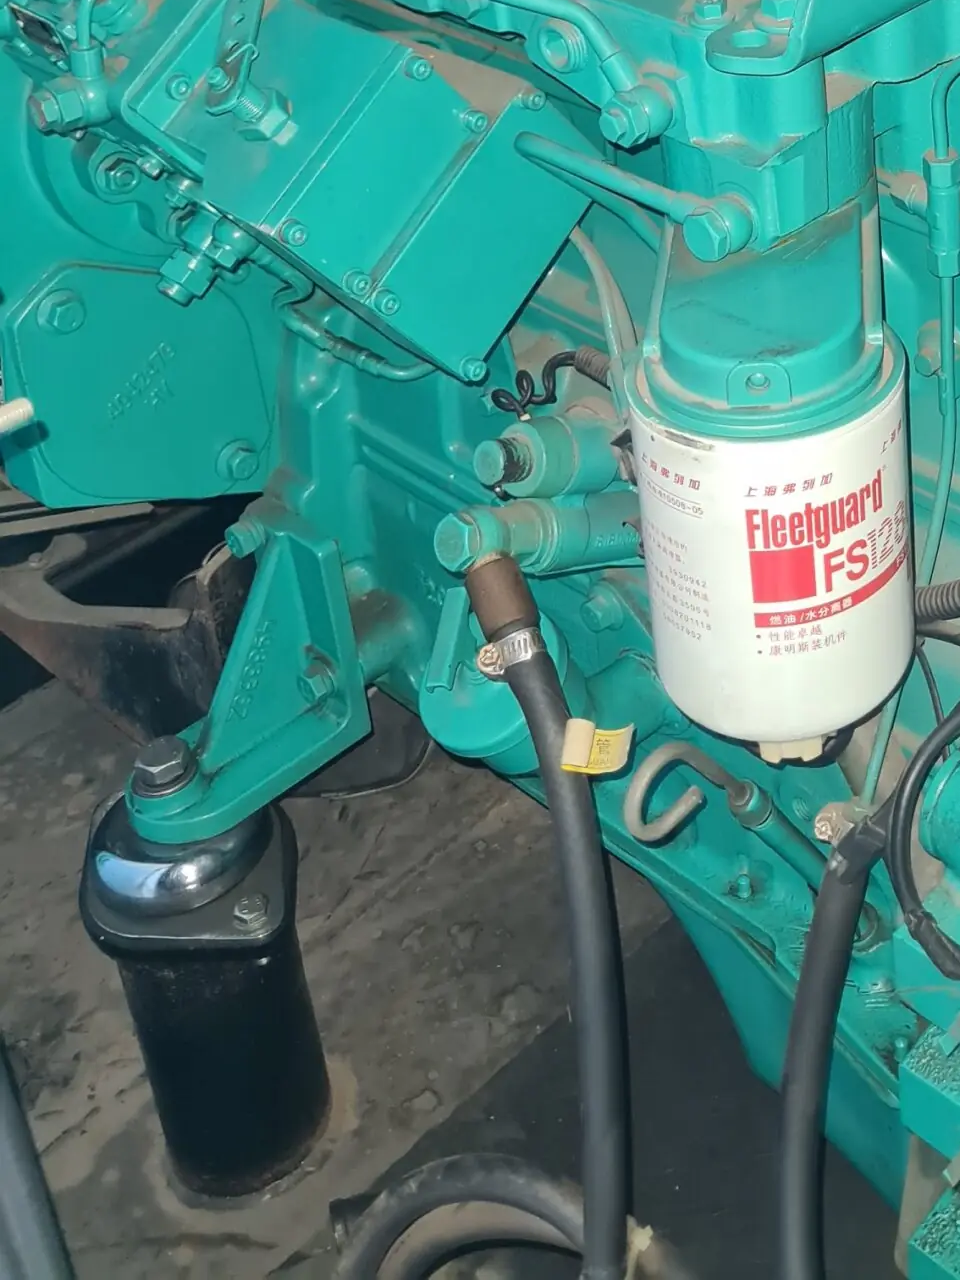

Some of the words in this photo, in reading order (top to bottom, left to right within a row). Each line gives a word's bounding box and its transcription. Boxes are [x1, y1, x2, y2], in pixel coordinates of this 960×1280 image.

[744, 472, 833, 497] 上海弗列加
[745, 468, 883, 550] Fleetguard
